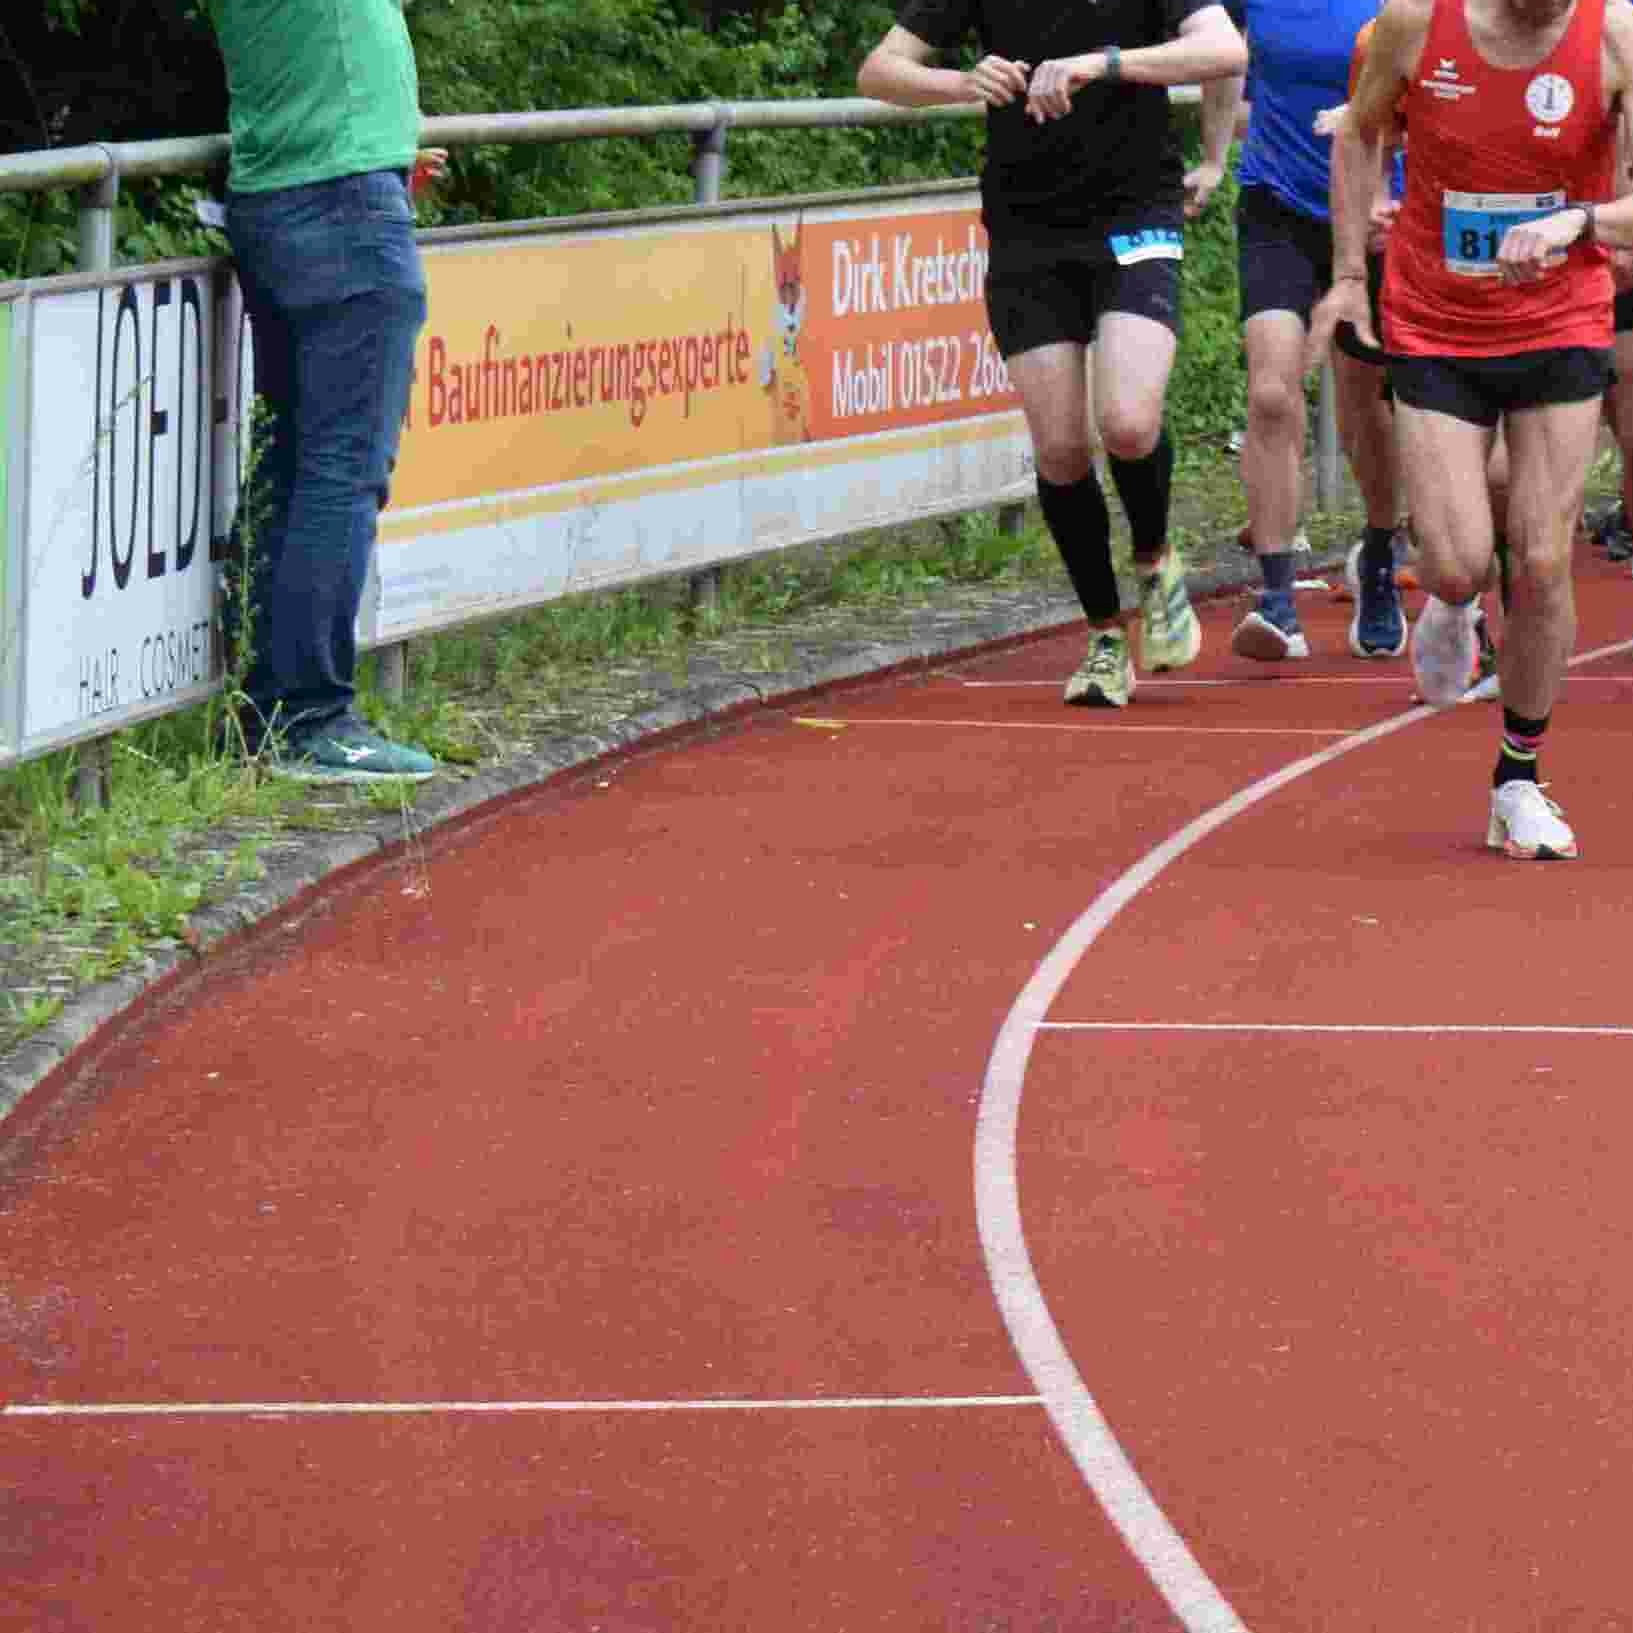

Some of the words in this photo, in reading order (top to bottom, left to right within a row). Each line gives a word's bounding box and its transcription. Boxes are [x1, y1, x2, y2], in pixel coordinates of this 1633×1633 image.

[831, 232, 888, 317] Dirk
[891, 223, 990, 309] Kretsch
[1460, 227, 1497, 261] 81
[427, 318, 751, 428] Baufinanzierungsexperte
[831, 342, 896, 417] Mobil
[901, 333, 960, 409] 01522
[79, 646, 120, 717] HAIR
[140, 620, 211, 698] COSMET
